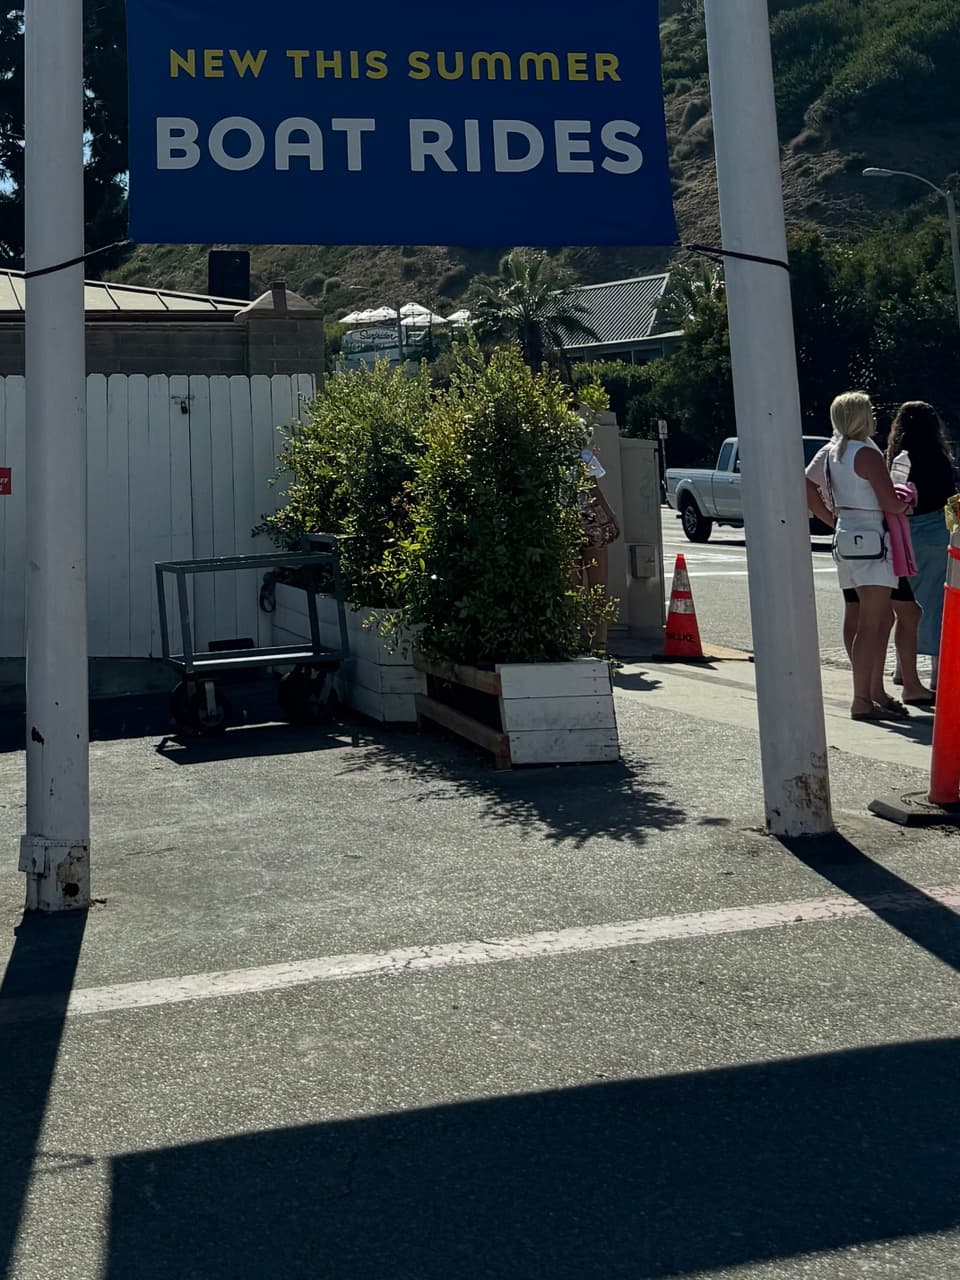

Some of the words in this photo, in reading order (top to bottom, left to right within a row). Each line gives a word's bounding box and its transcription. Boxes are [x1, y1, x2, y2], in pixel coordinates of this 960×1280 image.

[169, 48, 268, 79] NEW
[286, 49, 389, 80] THIS
[407, 50, 623, 82] SUMMER
[155, 115, 376, 172] BOAT
[408, 118, 644, 175] RIDES
